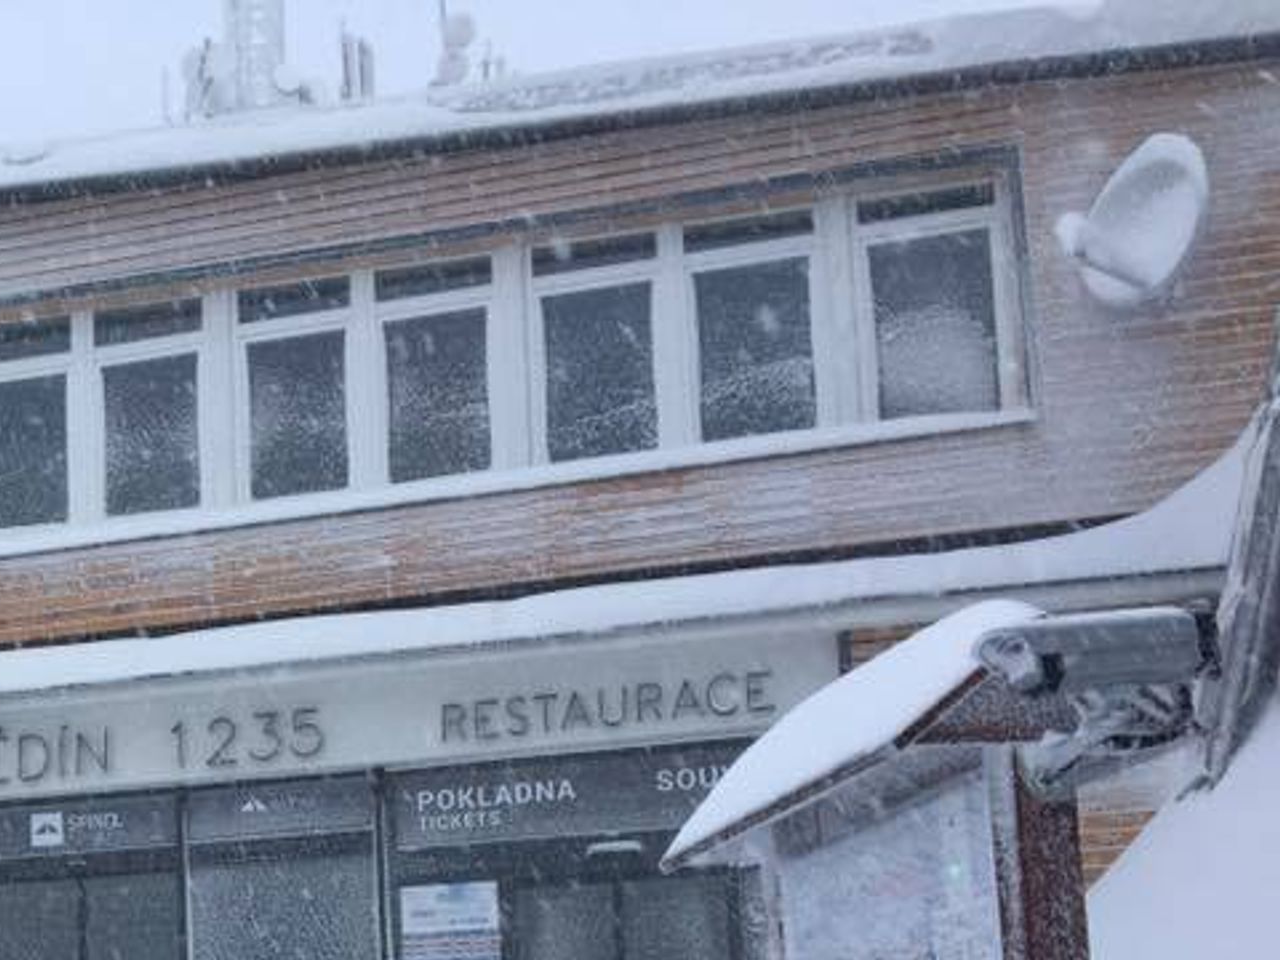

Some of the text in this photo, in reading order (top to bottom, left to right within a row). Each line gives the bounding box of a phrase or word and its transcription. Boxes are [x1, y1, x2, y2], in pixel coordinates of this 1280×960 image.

[440, 669, 778, 743] RESTAURACE
[170, 707, 326, 769] 1235
[417, 778, 578, 813] POKLADNA
[421, 810, 502, 833] TICKETS
